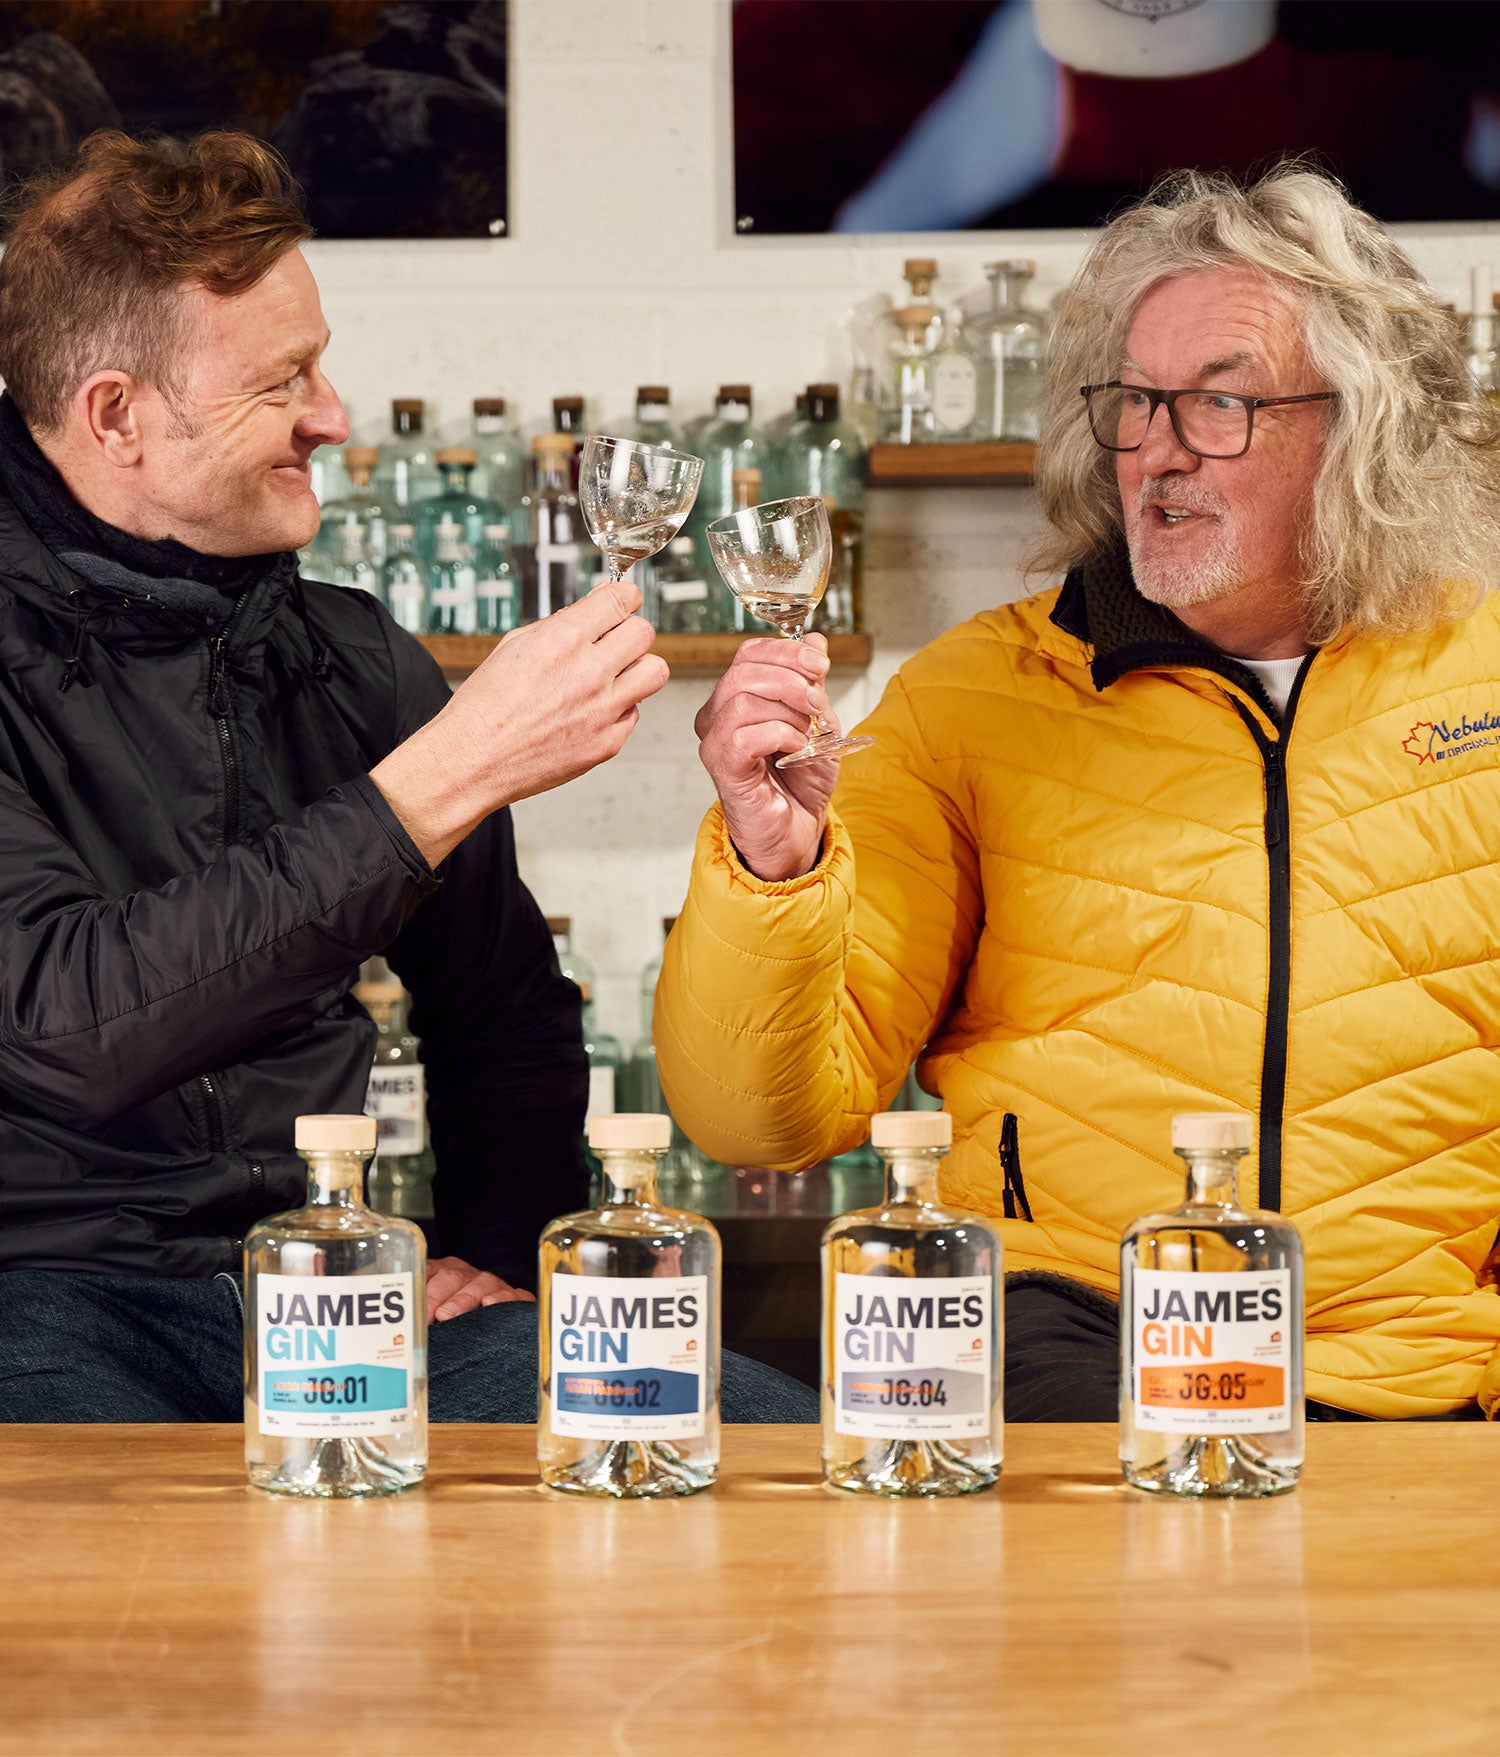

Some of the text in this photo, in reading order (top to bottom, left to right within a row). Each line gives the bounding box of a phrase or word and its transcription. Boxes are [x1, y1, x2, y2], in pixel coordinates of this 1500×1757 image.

[368, 1077, 415, 1095] MES
[266, 1290, 405, 1326] JAMES
[561, 1295, 698, 1329] JAMES
[846, 1295, 983, 1328] JAMES
[1143, 1288, 1282, 1322] JAMES
[266, 1327, 336, 1361] GIN
[560, 1328, 628, 1363] GIN
[844, 1328, 914, 1363] GIN
[1142, 1322, 1213, 1358] GIN
[304, 1375, 367, 1404] JG.01
[880, 1378, 947, 1407] JG.04
[1179, 1373, 1246, 1401] JG.05
